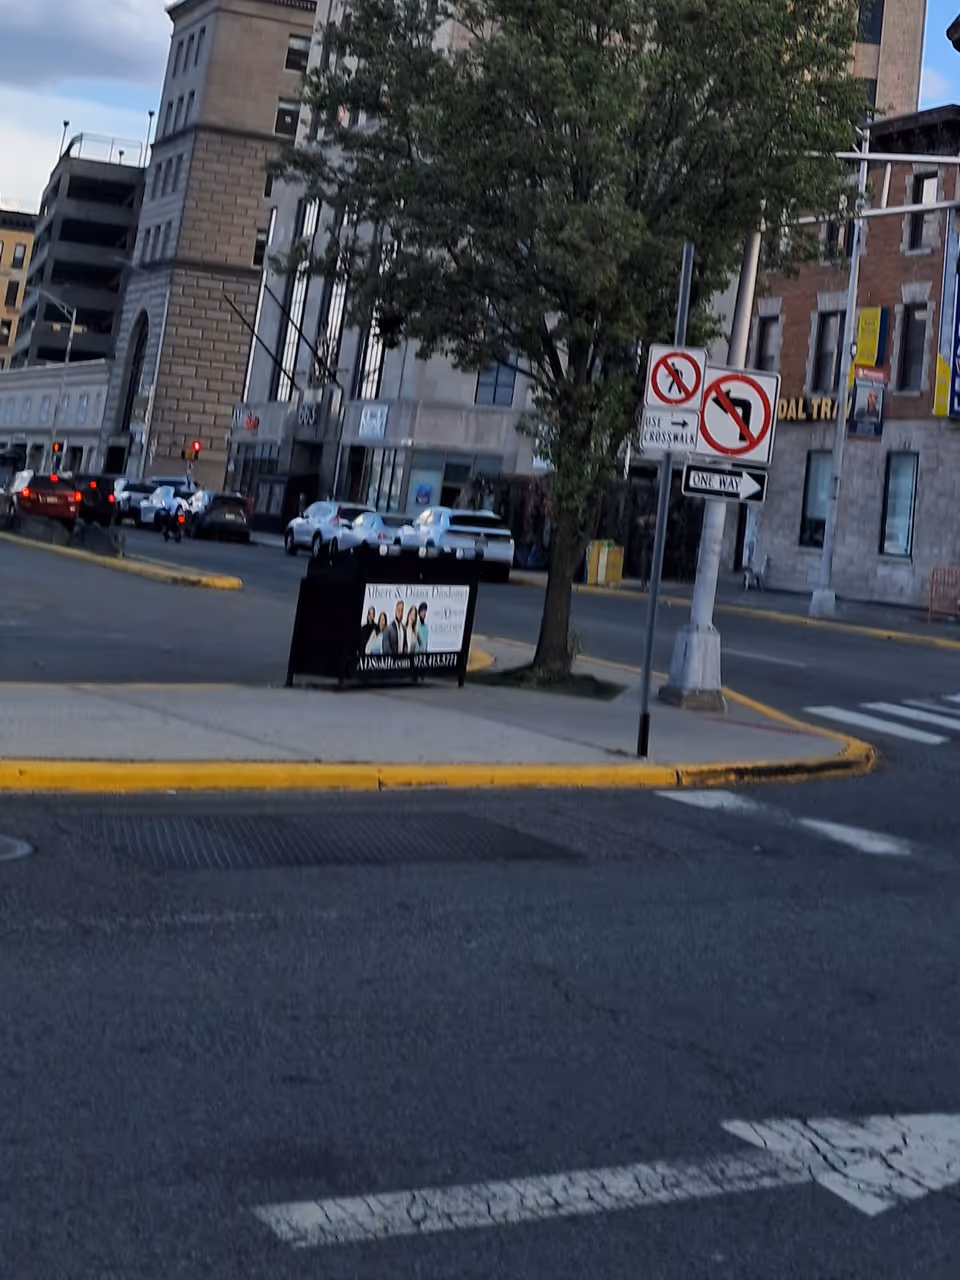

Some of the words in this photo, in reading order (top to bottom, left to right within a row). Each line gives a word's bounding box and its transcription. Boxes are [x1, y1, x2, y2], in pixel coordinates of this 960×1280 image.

[645, 416, 662, 429] USE
[643, 429, 695, 445] CROSSWALK
[692, 472, 715, 487] ONE
[719, 476, 740, 491] WAY
[394, 587, 402, 600] &
